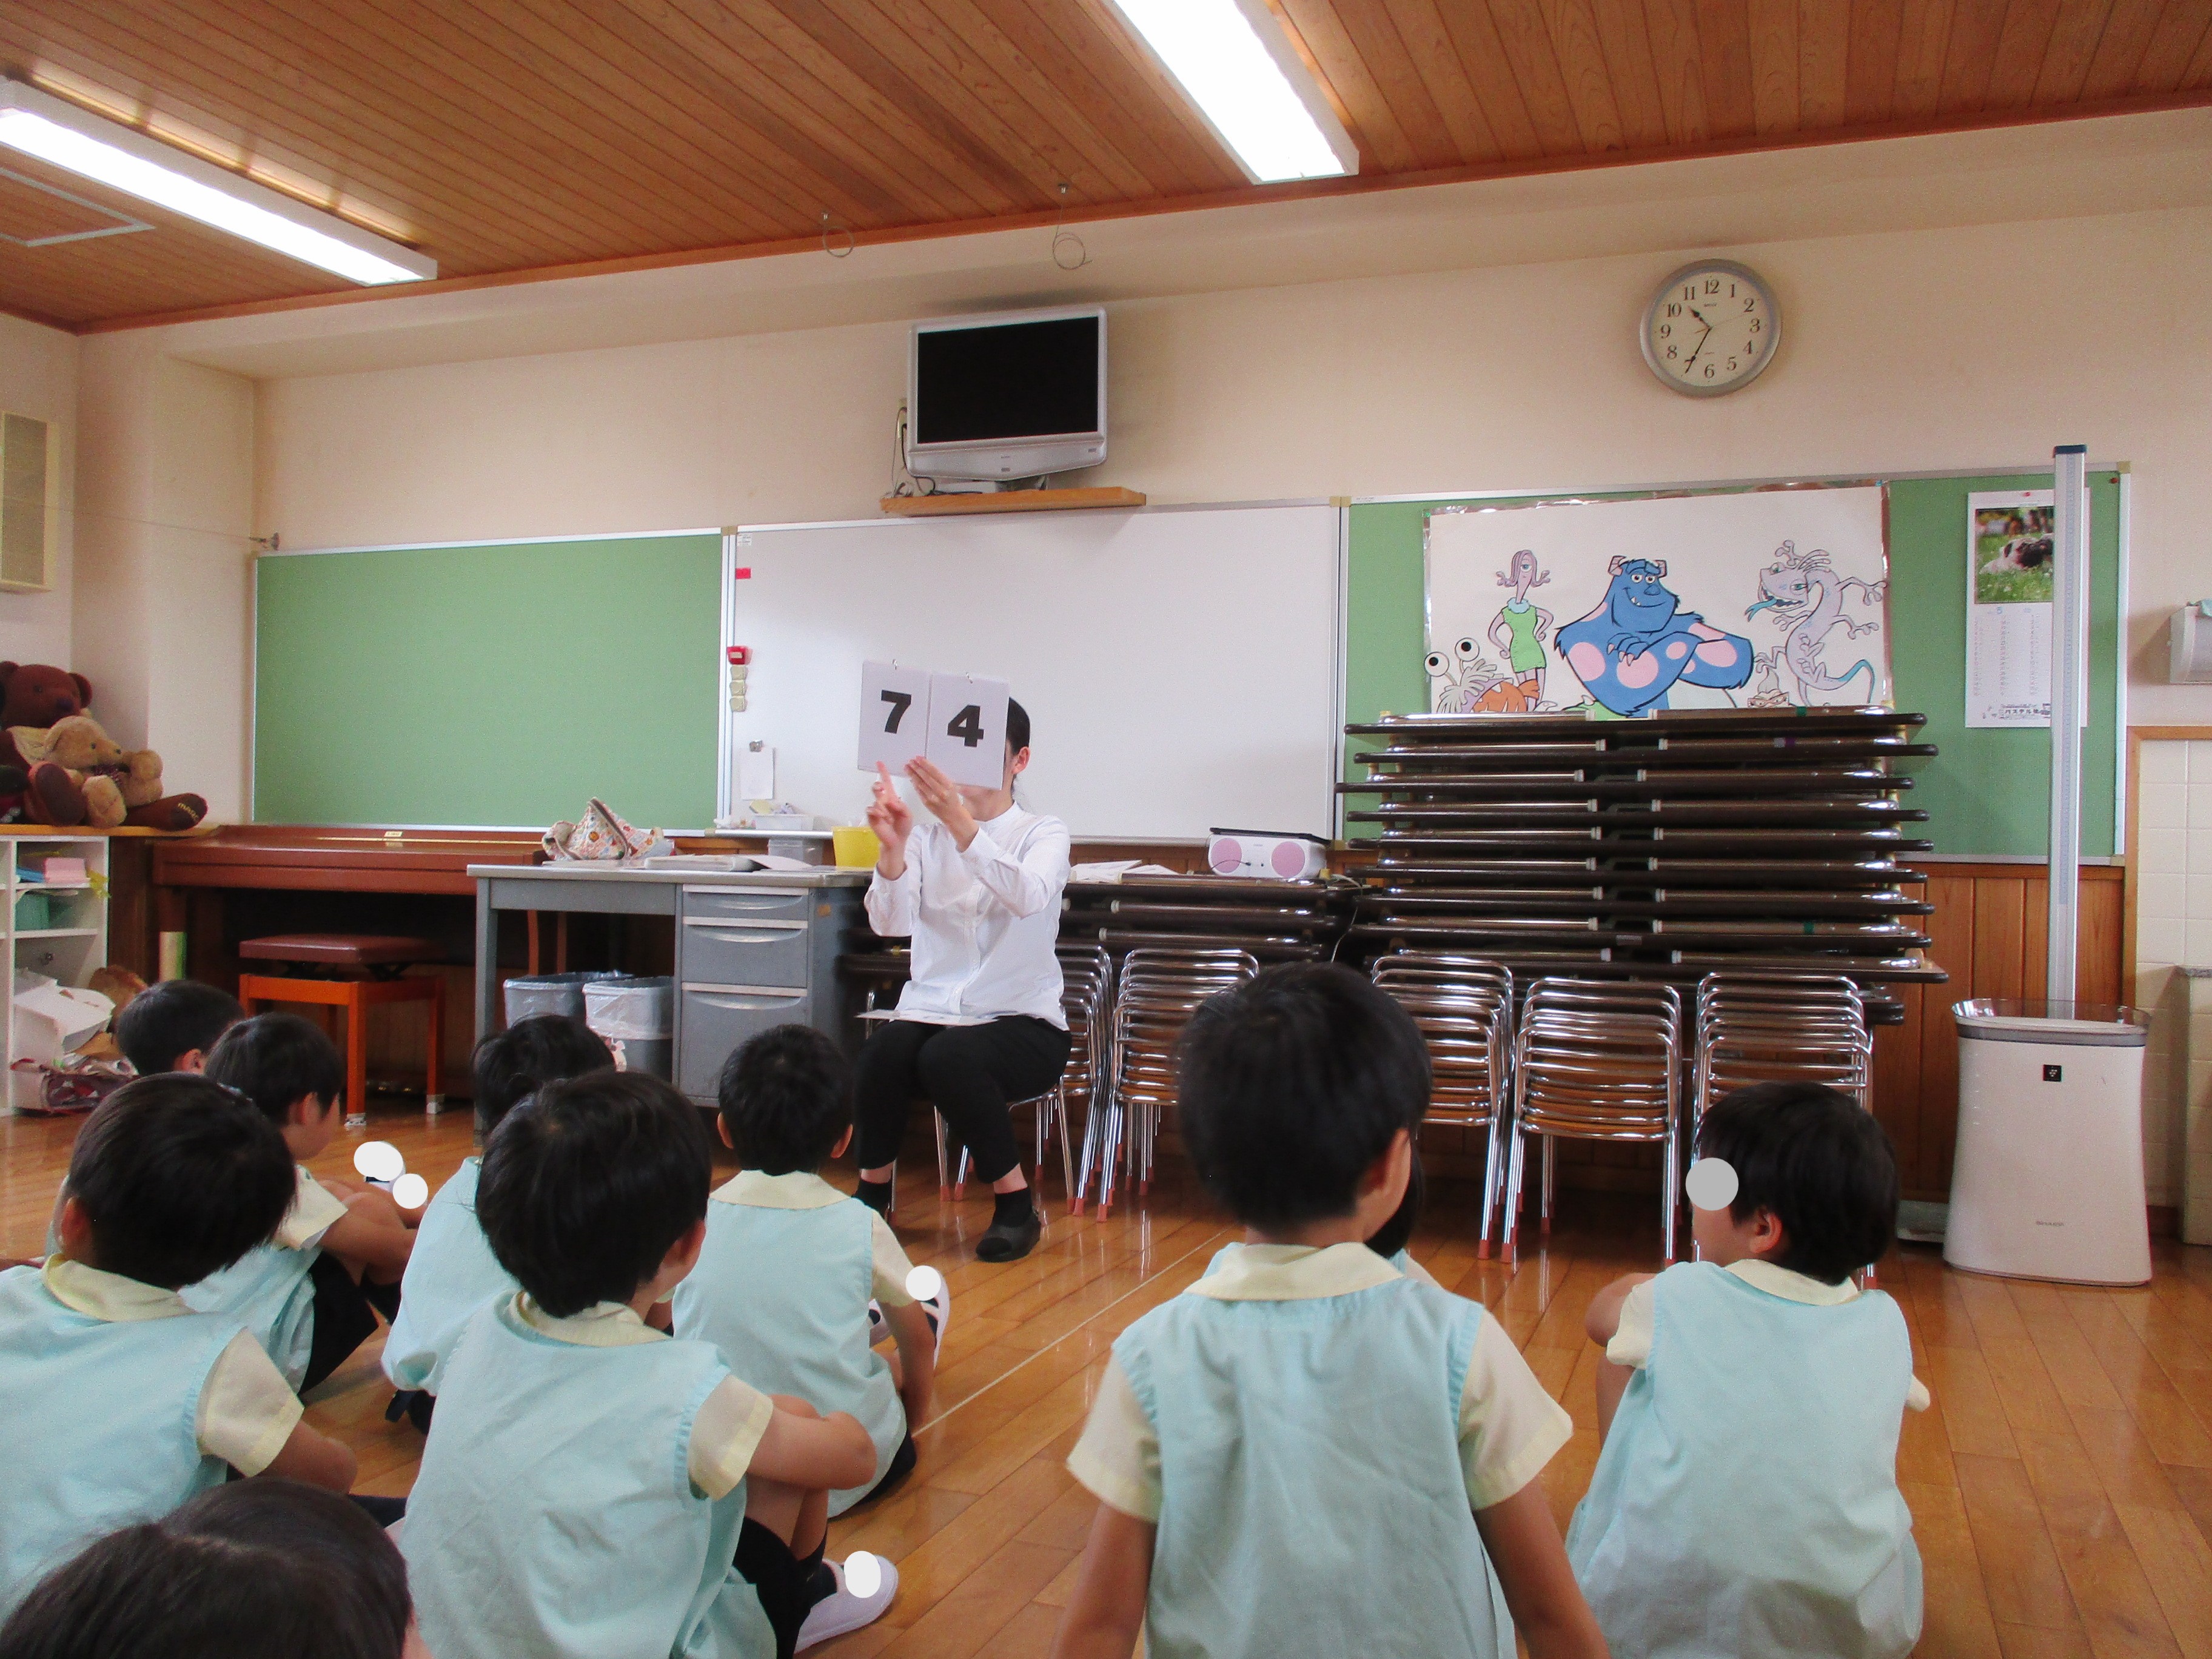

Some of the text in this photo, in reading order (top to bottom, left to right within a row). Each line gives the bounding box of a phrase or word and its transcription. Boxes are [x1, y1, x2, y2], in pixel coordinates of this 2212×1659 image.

[1684, 286, 1695, 301] 11
[1704, 280, 1720, 294] 12
[1730, 284, 1735, 298] 1
[1667, 303, 1682, 318] 10
[1744, 298, 1754, 313] 2
[1660, 324, 1671, 339] 9
[1749, 318, 1760, 333] 3
[1667, 345, 1677, 360] 8
[1743, 340, 1752, 354] 4
[1704, 364, 1715, 378] 6
[1727, 357, 1737, 371] 5
[880, 689, 984, 748] 7 4
